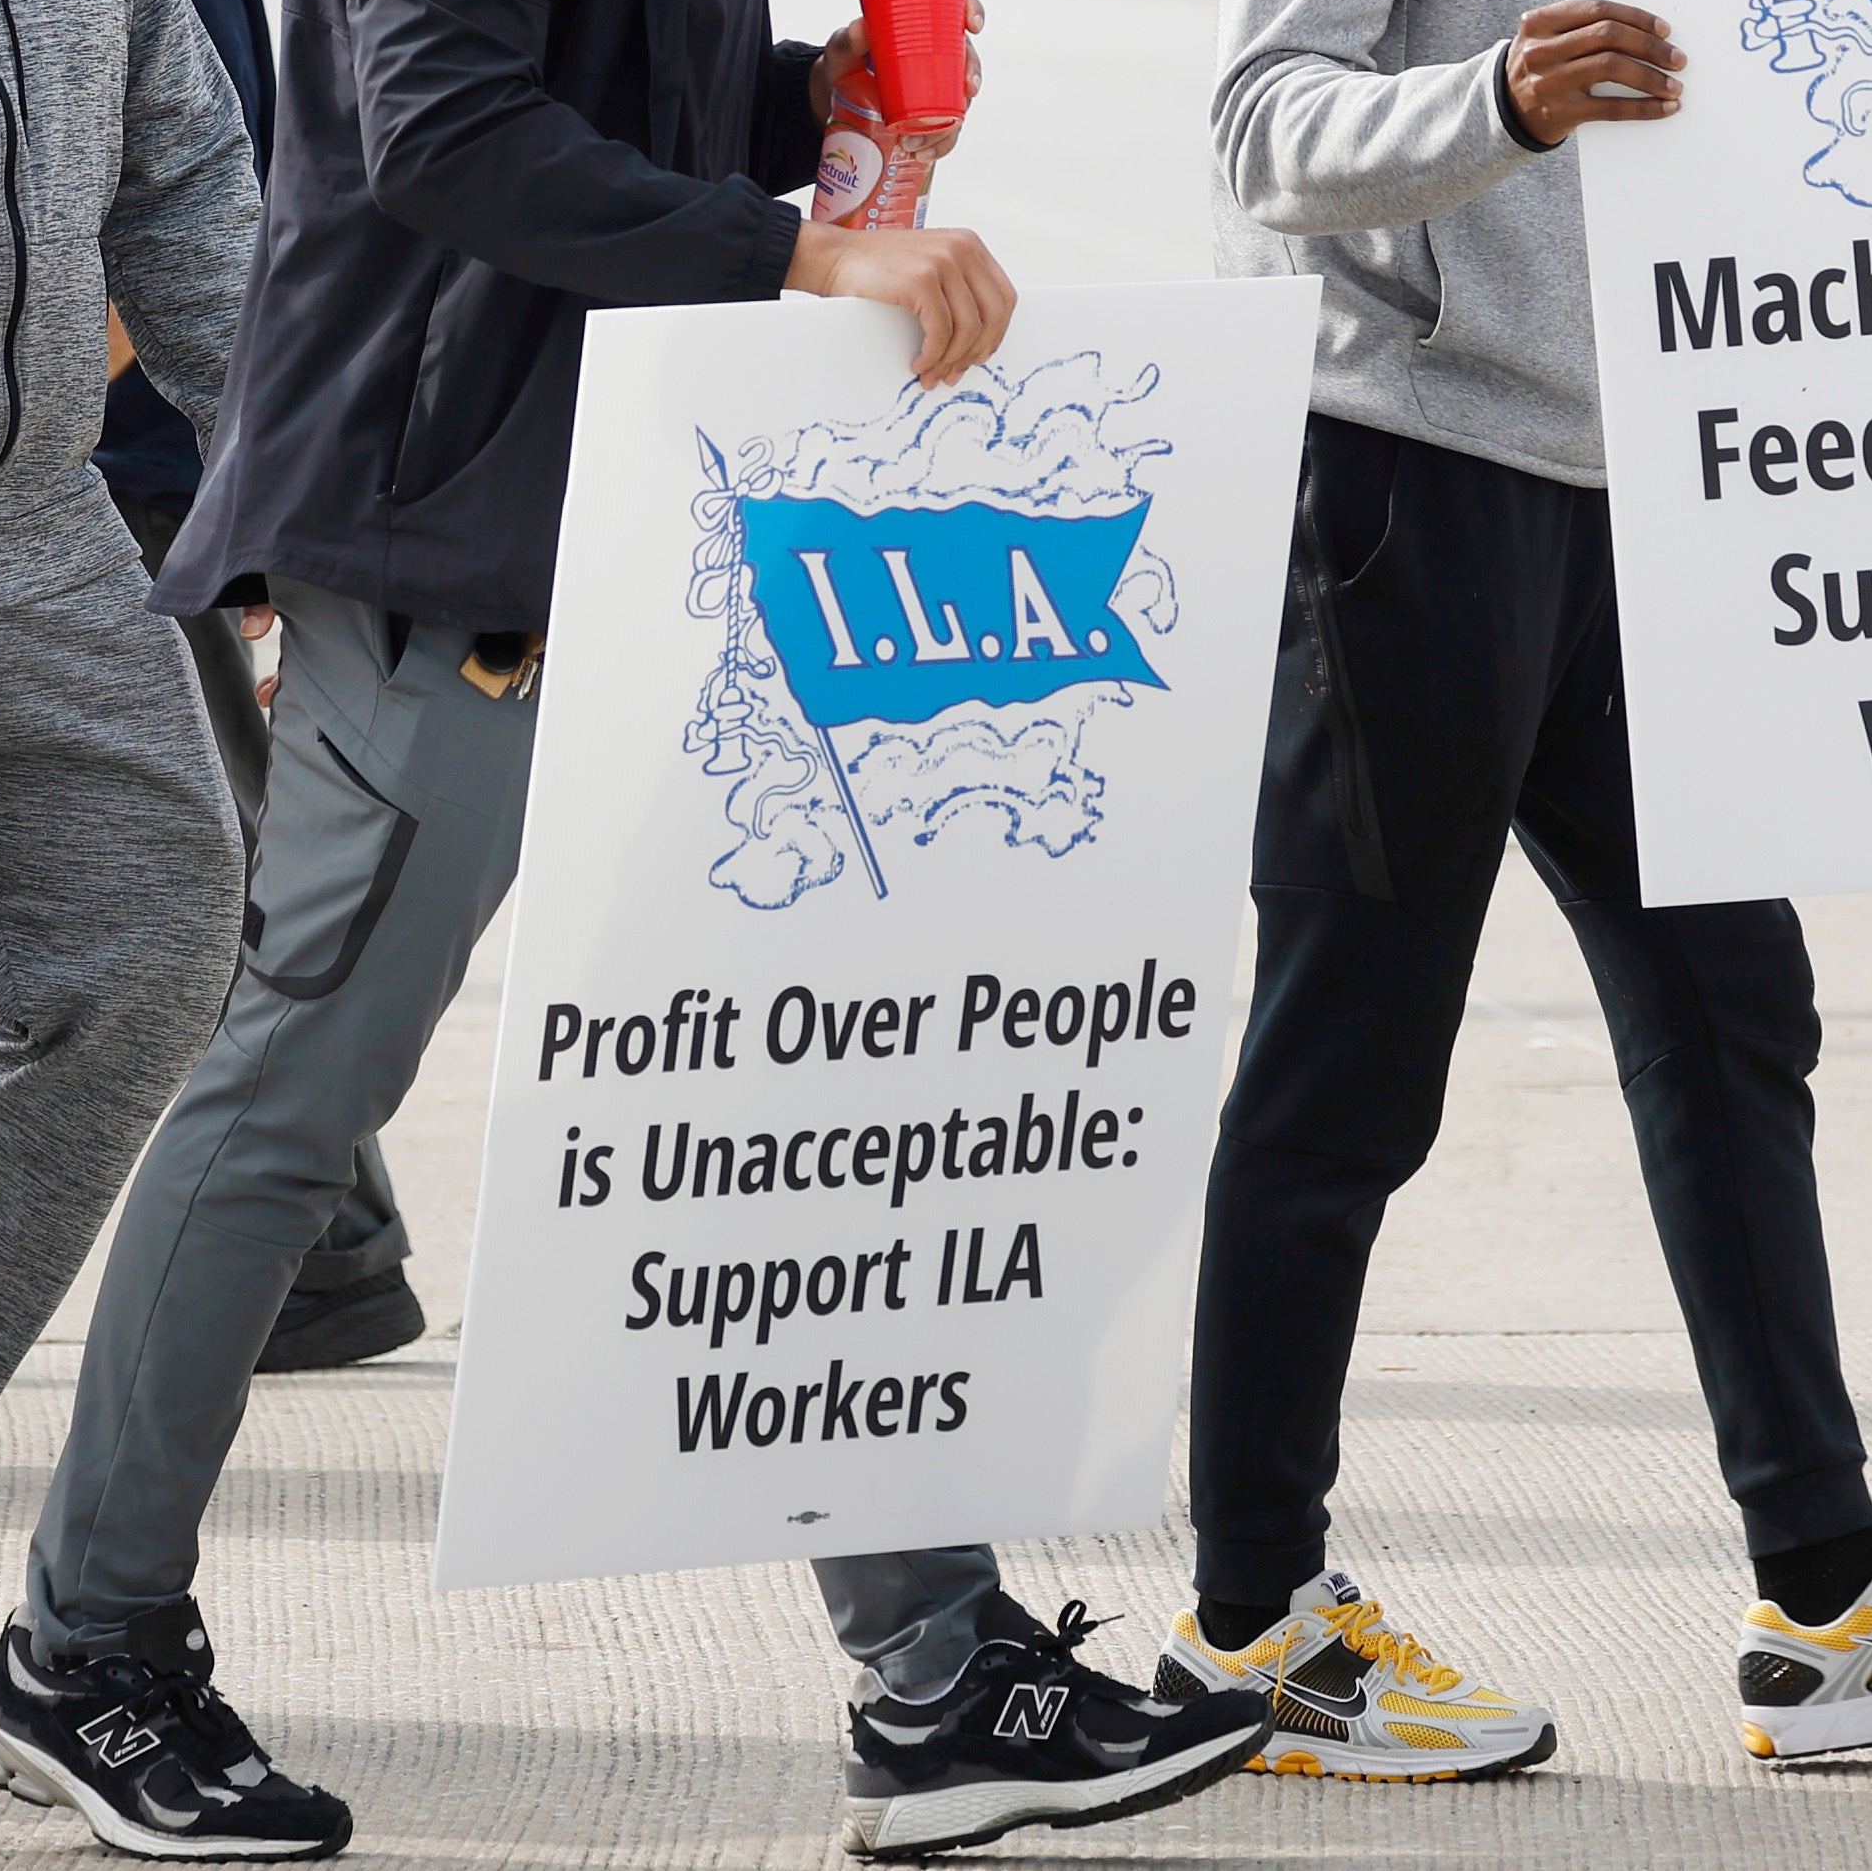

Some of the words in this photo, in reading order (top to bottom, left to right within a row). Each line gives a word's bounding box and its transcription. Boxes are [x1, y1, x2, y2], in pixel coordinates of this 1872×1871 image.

[791, 544, 1114, 671] I.L.A.
[538, 989, 742, 1082] Profit
[766, 985, 936, 1066] Over
[958, 958, 1197, 1070] People
[558, 1127, 615, 1209] is
[642, 1089, 1145, 1209] Unacceptable:
[625, 1238, 913, 1349] Support
[937, 1223, 1044, 1306] ILA
[676, 1359, 972, 1454] Workers
